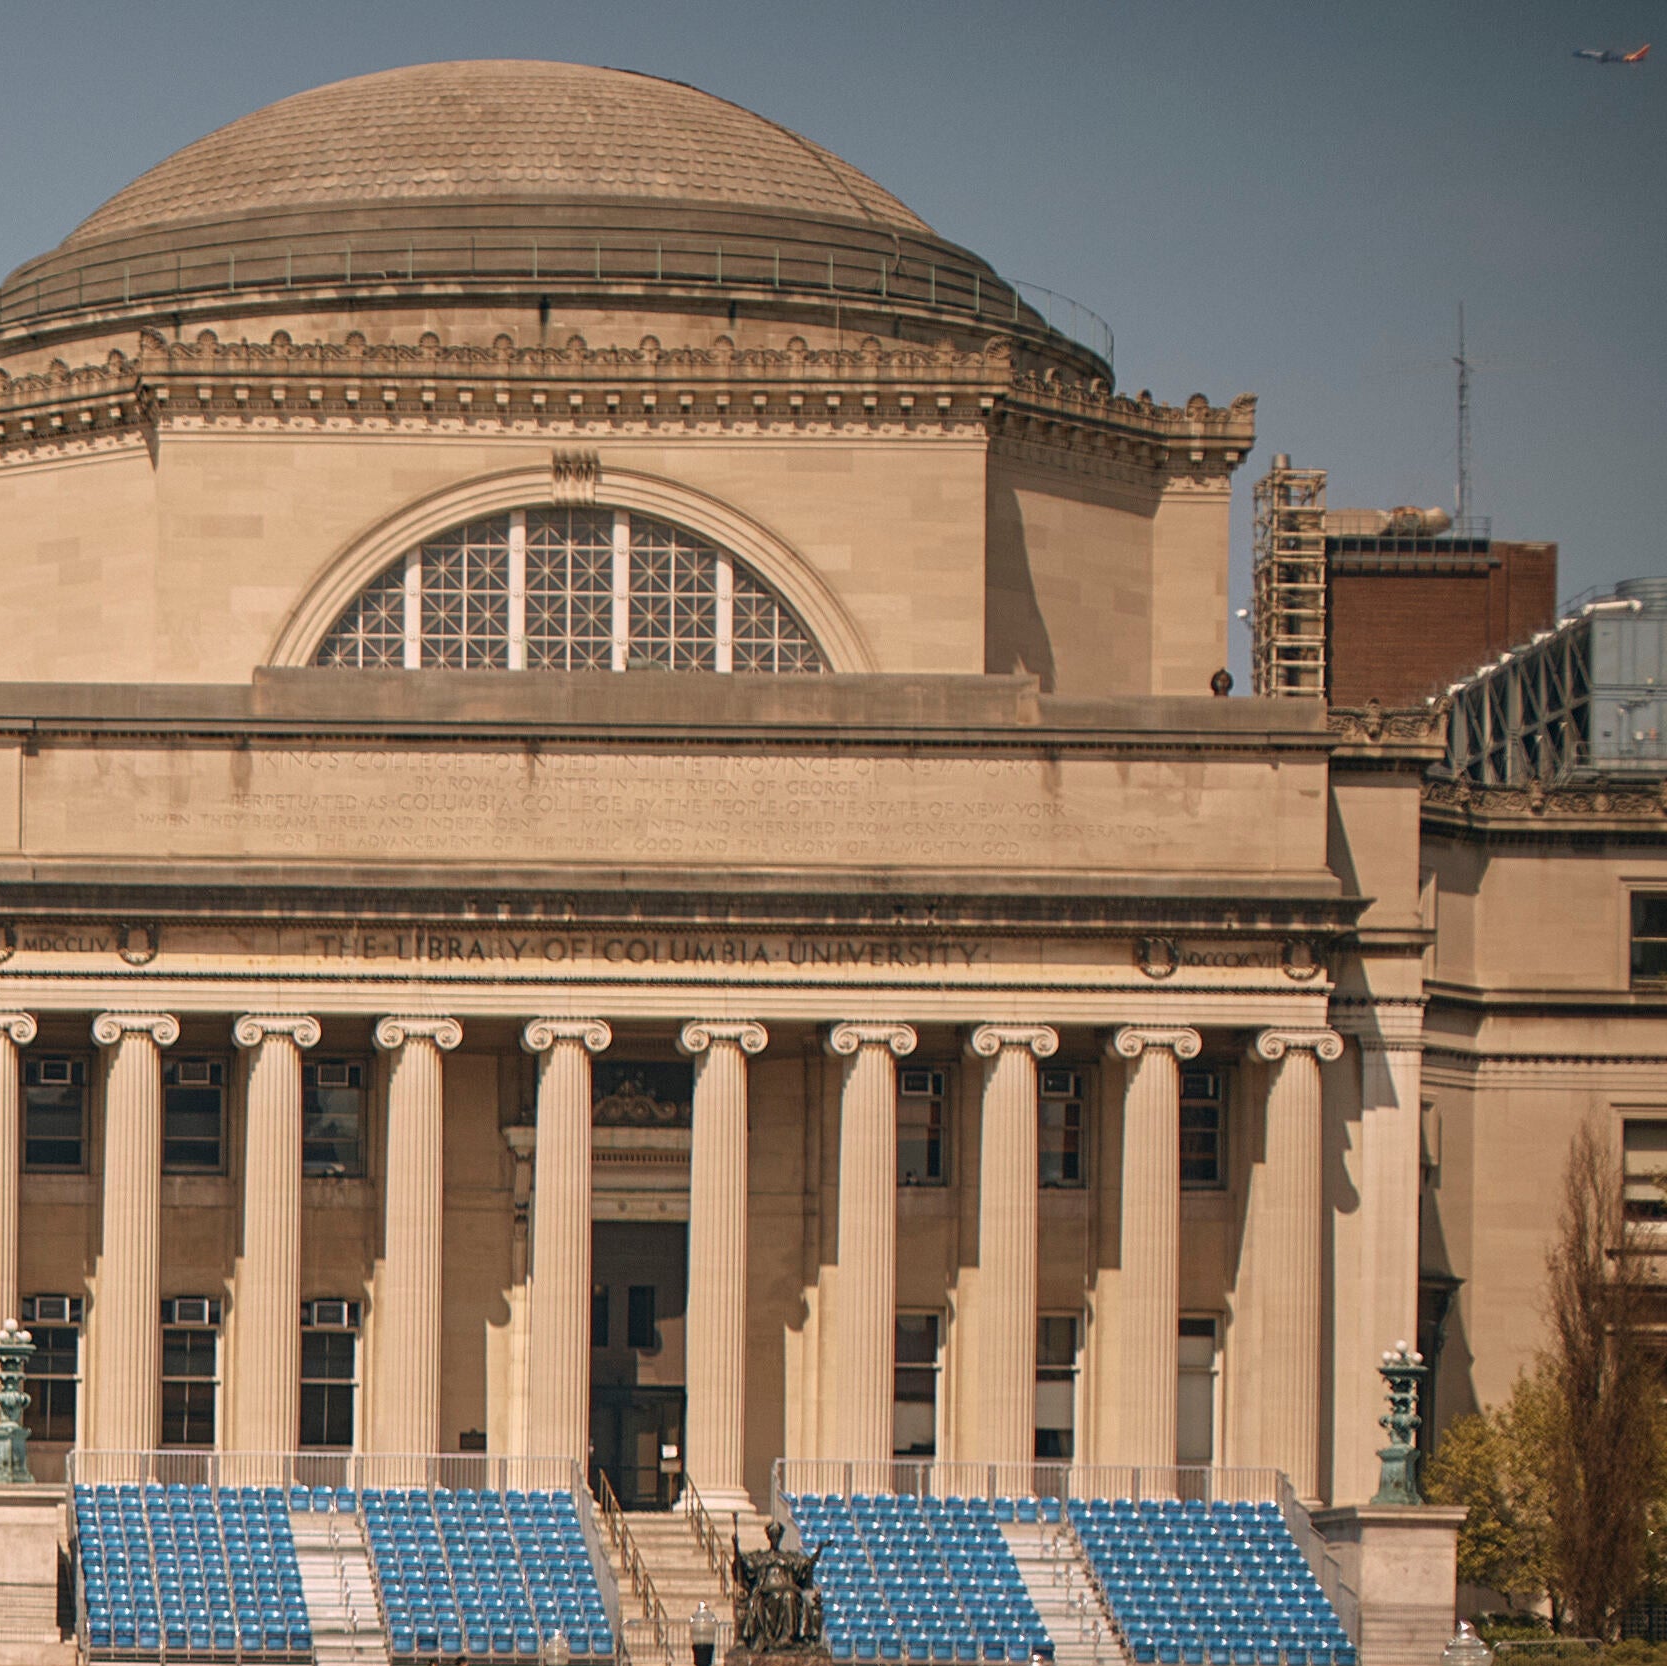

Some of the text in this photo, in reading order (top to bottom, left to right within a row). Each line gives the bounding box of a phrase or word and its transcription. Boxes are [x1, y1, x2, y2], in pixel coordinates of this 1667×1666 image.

[354, 752, 466, 770] COLLEGE
[481, 752, 598, 772] FOUNDED
[719, 756, 840, 775] PROVINCE
[970, 760, 1035, 778] YORK
[415, 775, 437, 792] BY
[448, 776, 505, 793] ROYAL
[516, 776, 600, 795] CHARTER
[609, 778, 629, 795] IN
[639, 778, 674, 795] THE
[687, 779, 740, 796] REIGN
[751, 780, 777, 796] OF
[786, 780, 860, 797] GEORGE
[230, 793, 1066, 819] PERPETUATED AS COLUMBIA COLLEGE BY THE PEOPLE OF THE STATE OF NEW YORK
[139, 813, 1158, 839] WHEN THEY BECAME FREE AND INDEPENDENT MAINTAINED AND CHERISHED FROM GENERATION TO GENERATION
[272, 833, 1020, 856] FOR THE ADVANCEMENT OF THE PUBLIC GOOD AND THE GLORY OF ALMIGHTY GOD
[24, 937, 109, 952] MDCCLIV
[315, 935, 982, 968] THE LIBRARY OF COLUMBIA UNIVERSITY
